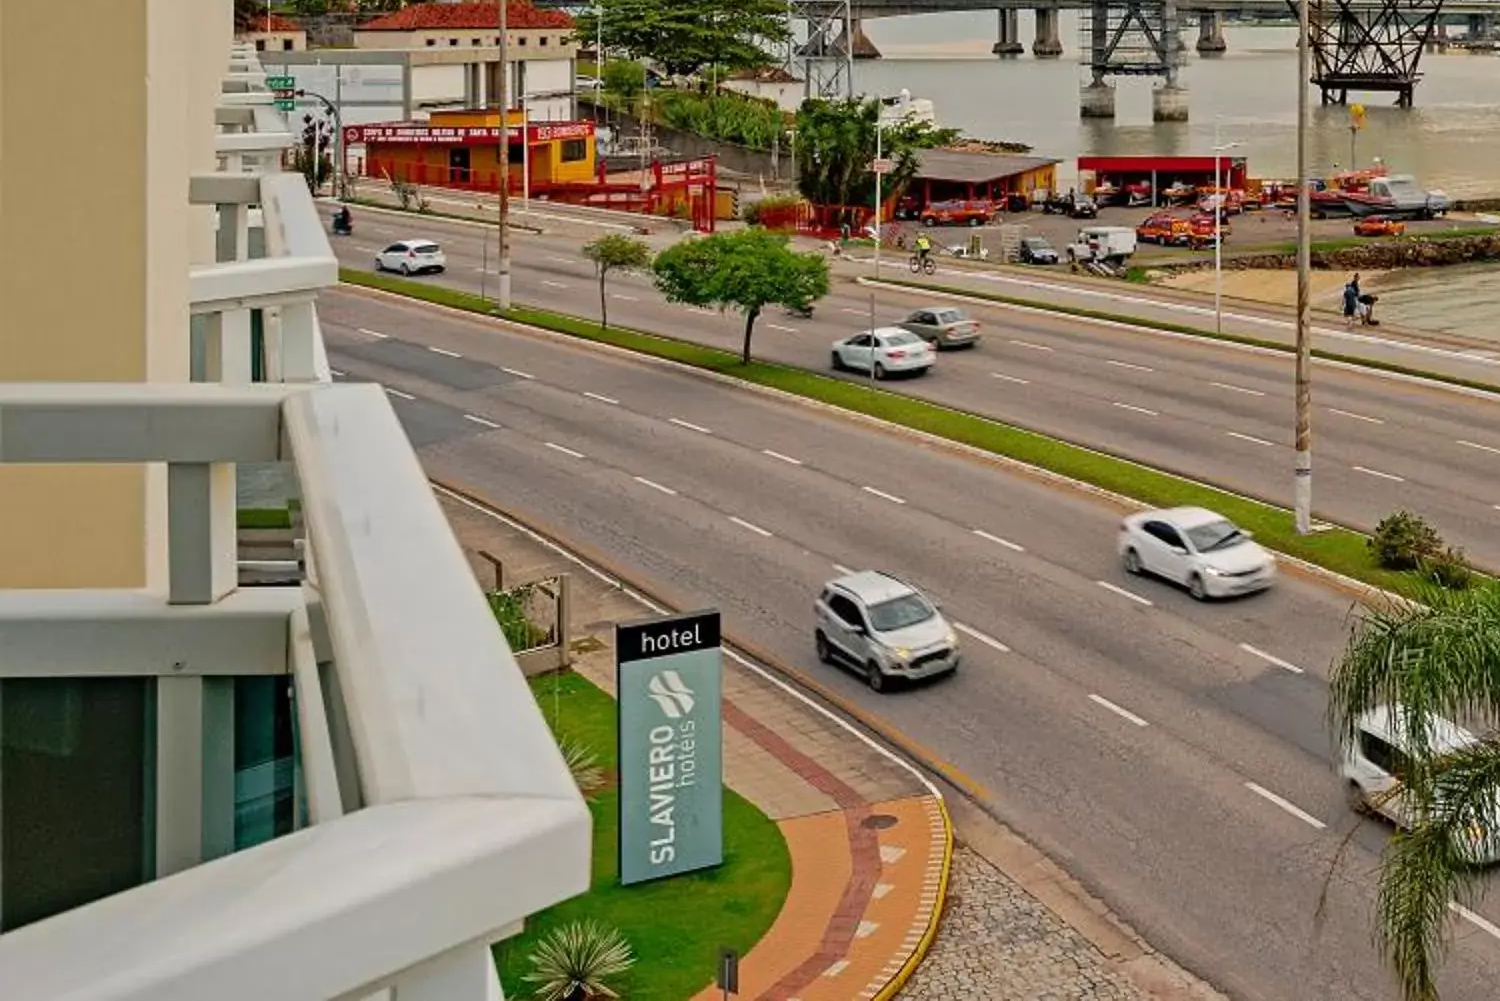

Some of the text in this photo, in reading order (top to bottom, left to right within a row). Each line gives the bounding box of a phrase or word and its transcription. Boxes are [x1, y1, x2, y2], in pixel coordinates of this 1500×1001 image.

[641, 623, 703, 652] hotel
[675, 720, 696, 788] hotels
[650, 724, 675, 865] SLAVIERO
